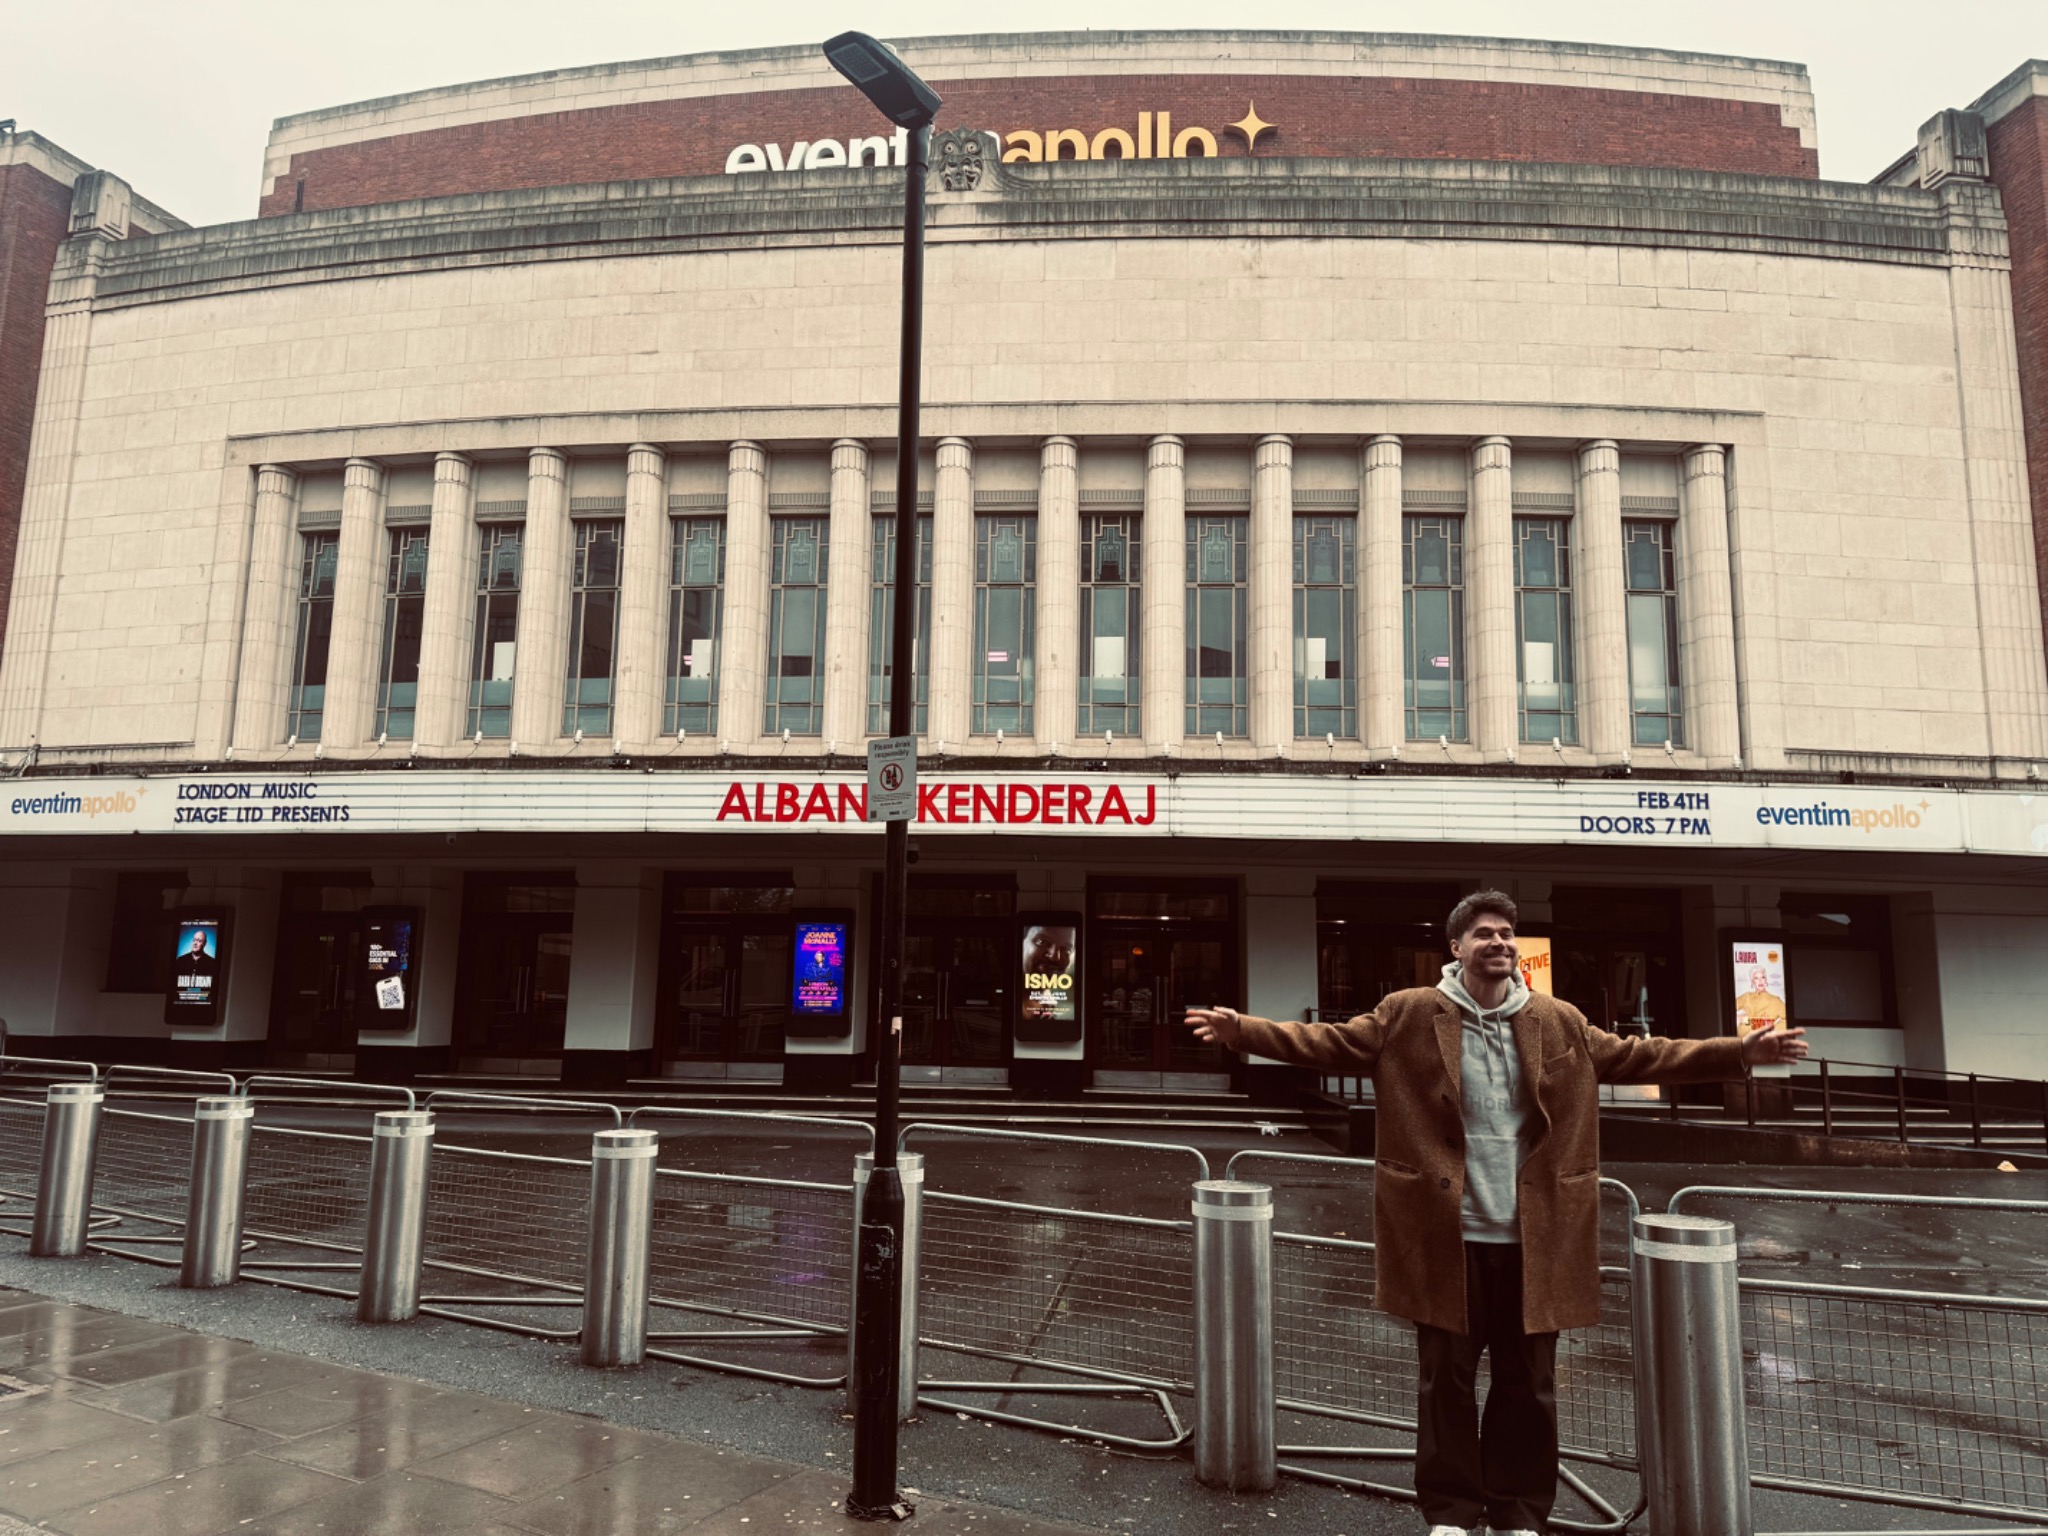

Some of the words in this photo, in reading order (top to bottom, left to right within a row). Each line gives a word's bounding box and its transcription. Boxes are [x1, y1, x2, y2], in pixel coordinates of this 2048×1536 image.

[177, 784, 250, 800] LONDON
[261, 783, 318, 799] MUSIC
[716, 782, 868, 823] ALBAN
[917, 784, 1157, 825] KENDERAJ
[1638, 791, 1670, 810] FEB
[1674, 792, 1710, 811] 4TH
[174, 807, 228, 823] STAGE
[236, 807, 262, 822] LTD
[272, 806, 350, 822] PRESENTS
[1580, 815, 1656, 835] DOORS
[1665, 817, 1676, 835] 7
[1681, 817, 1711, 836] PM
[1735, 951, 1758, 965] LAURA
[1025, 973, 1073, 990] ISMO
